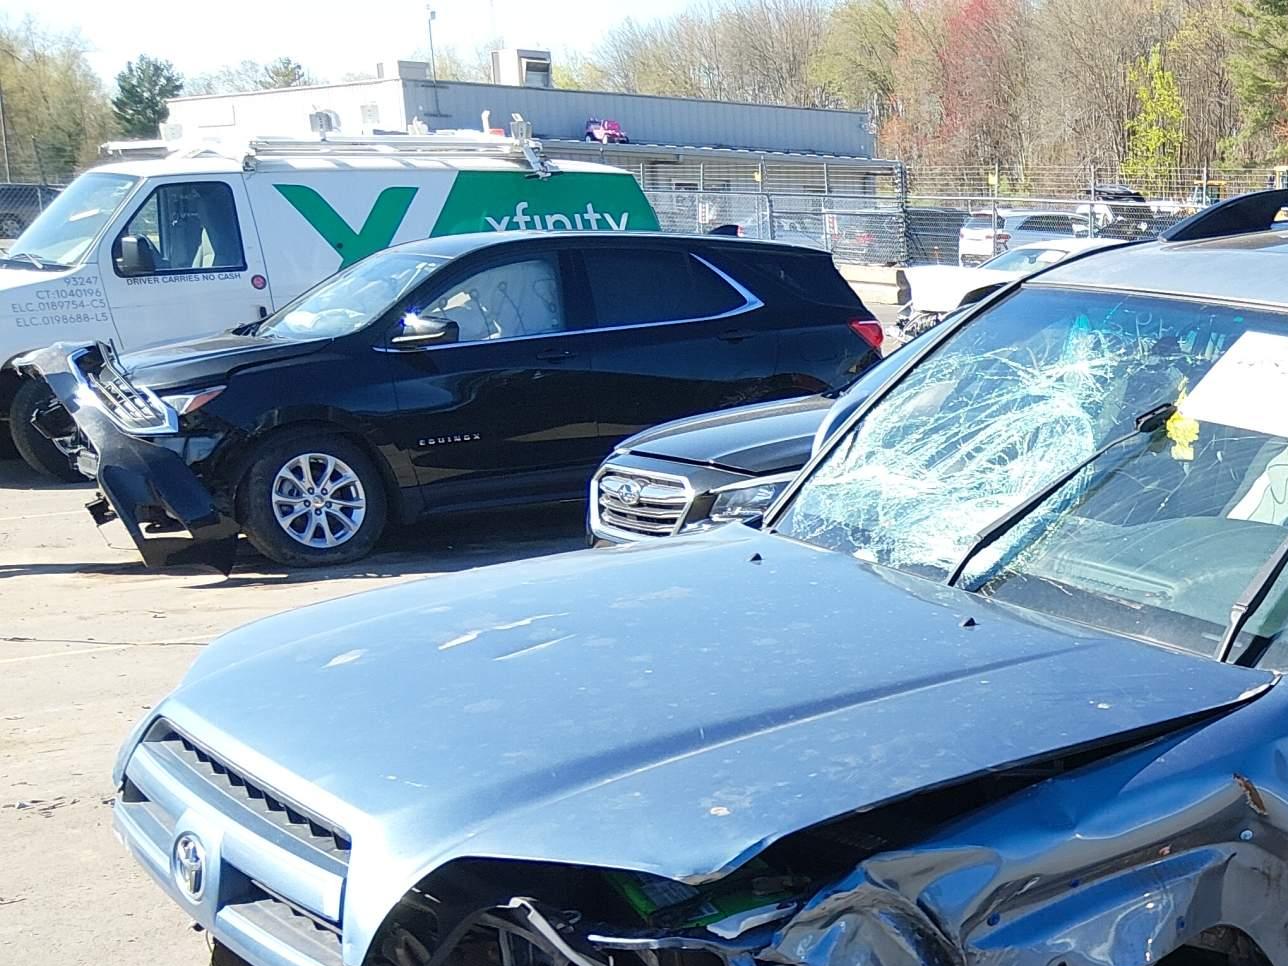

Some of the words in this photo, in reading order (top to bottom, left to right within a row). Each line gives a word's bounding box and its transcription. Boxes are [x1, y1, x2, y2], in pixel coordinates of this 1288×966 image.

[126, 277, 160, 286] DRIVER
[161, 275, 201, 284] CARRIES
[202, 273, 216, 282] NO
[218, 272, 242, 281] CASH
[419, 432, 481, 447] EQUINOX
